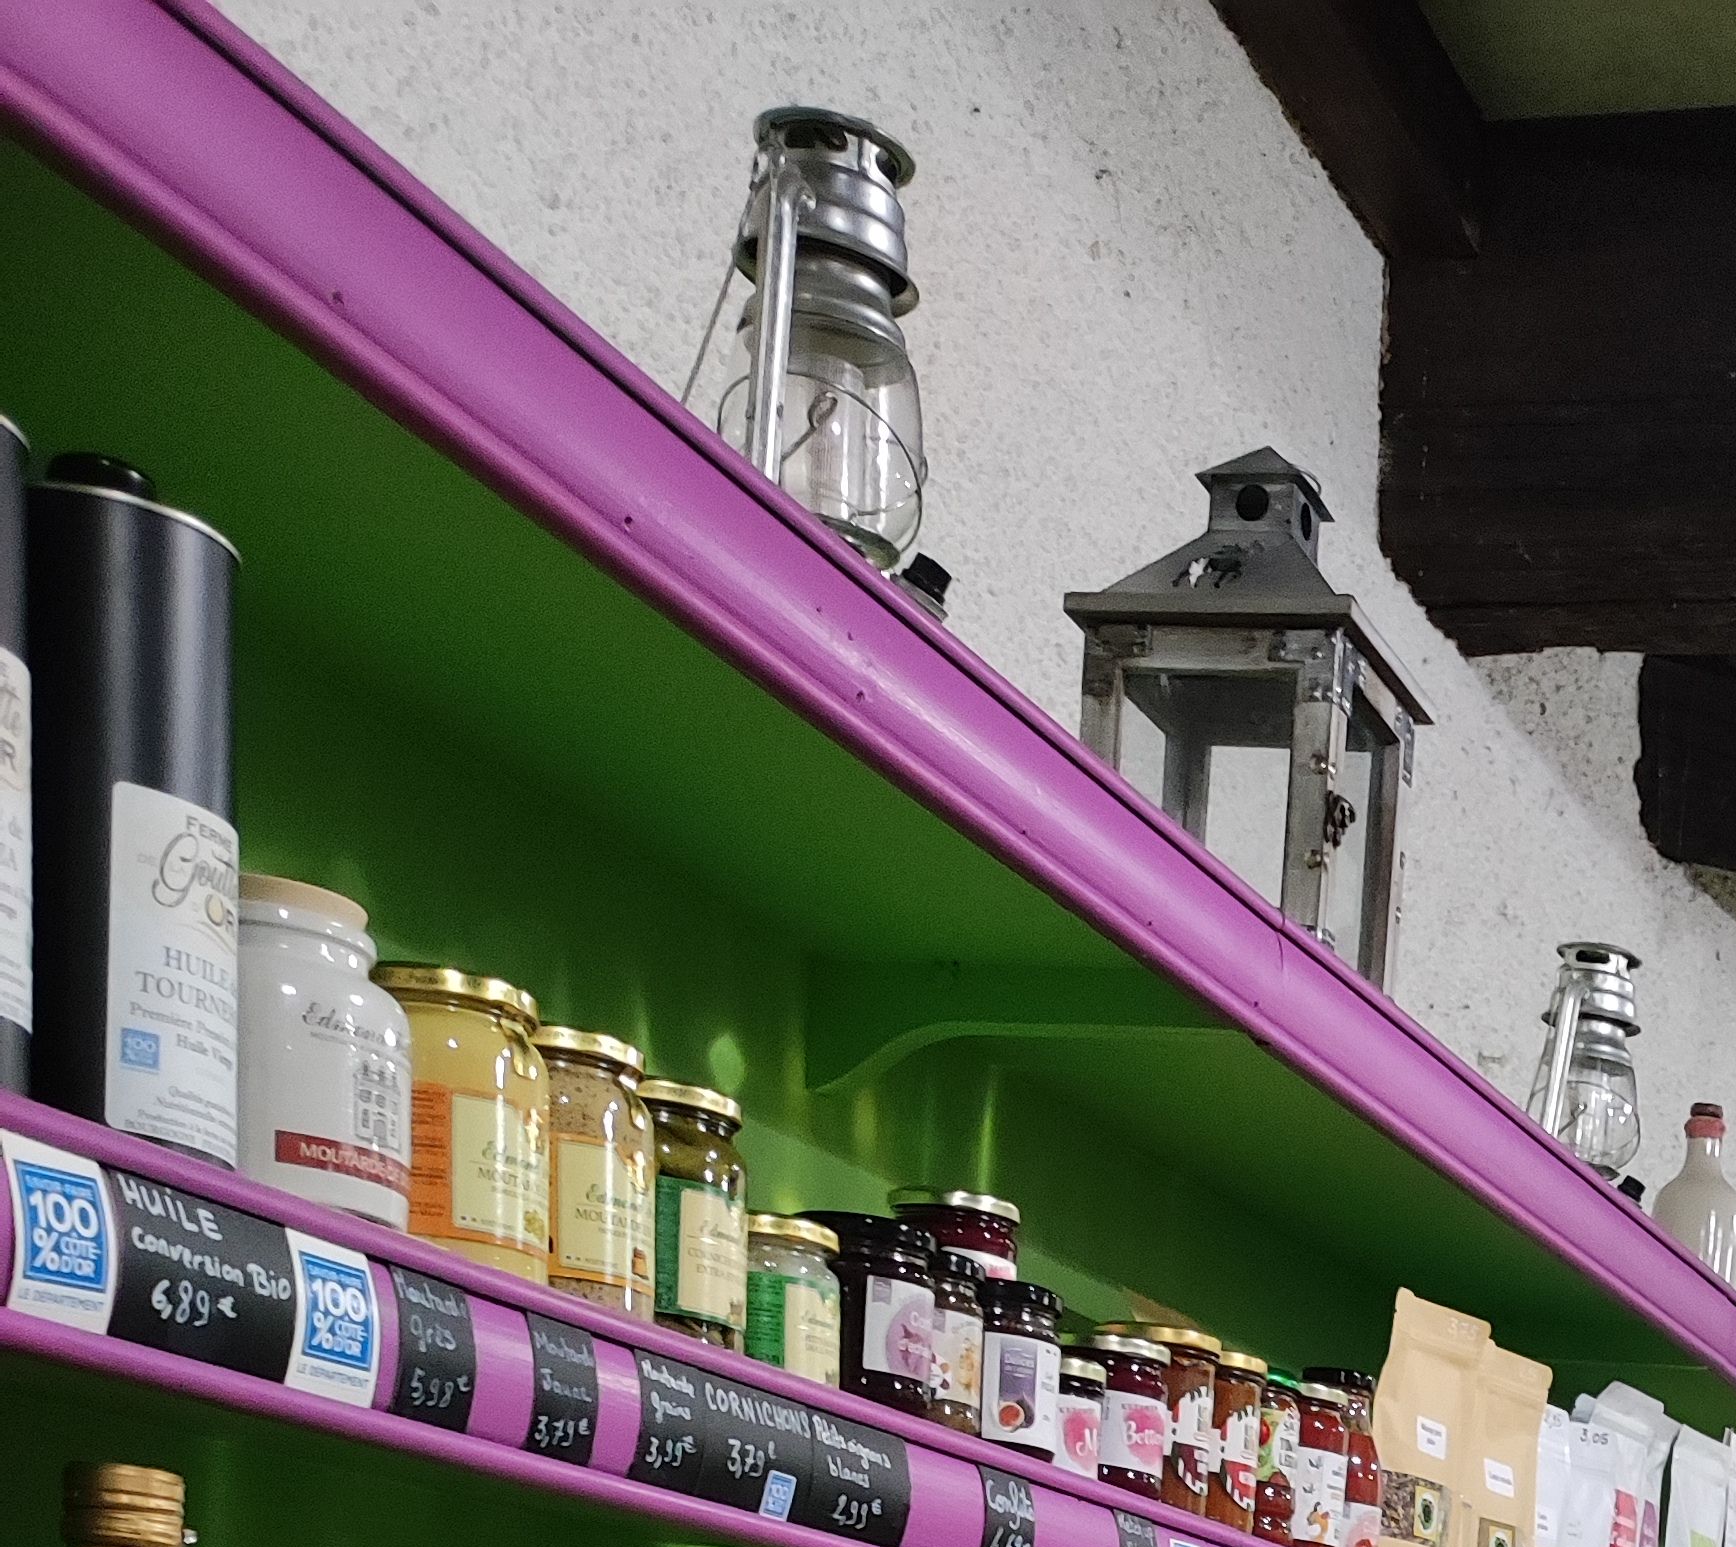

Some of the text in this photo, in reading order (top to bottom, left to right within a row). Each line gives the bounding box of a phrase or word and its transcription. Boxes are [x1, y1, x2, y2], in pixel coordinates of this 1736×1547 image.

[29, 1189, 99, 1238] 100
[131, 1225, 293, 1301] conversion Bio
[311, 1280, 368, 1323] 100
